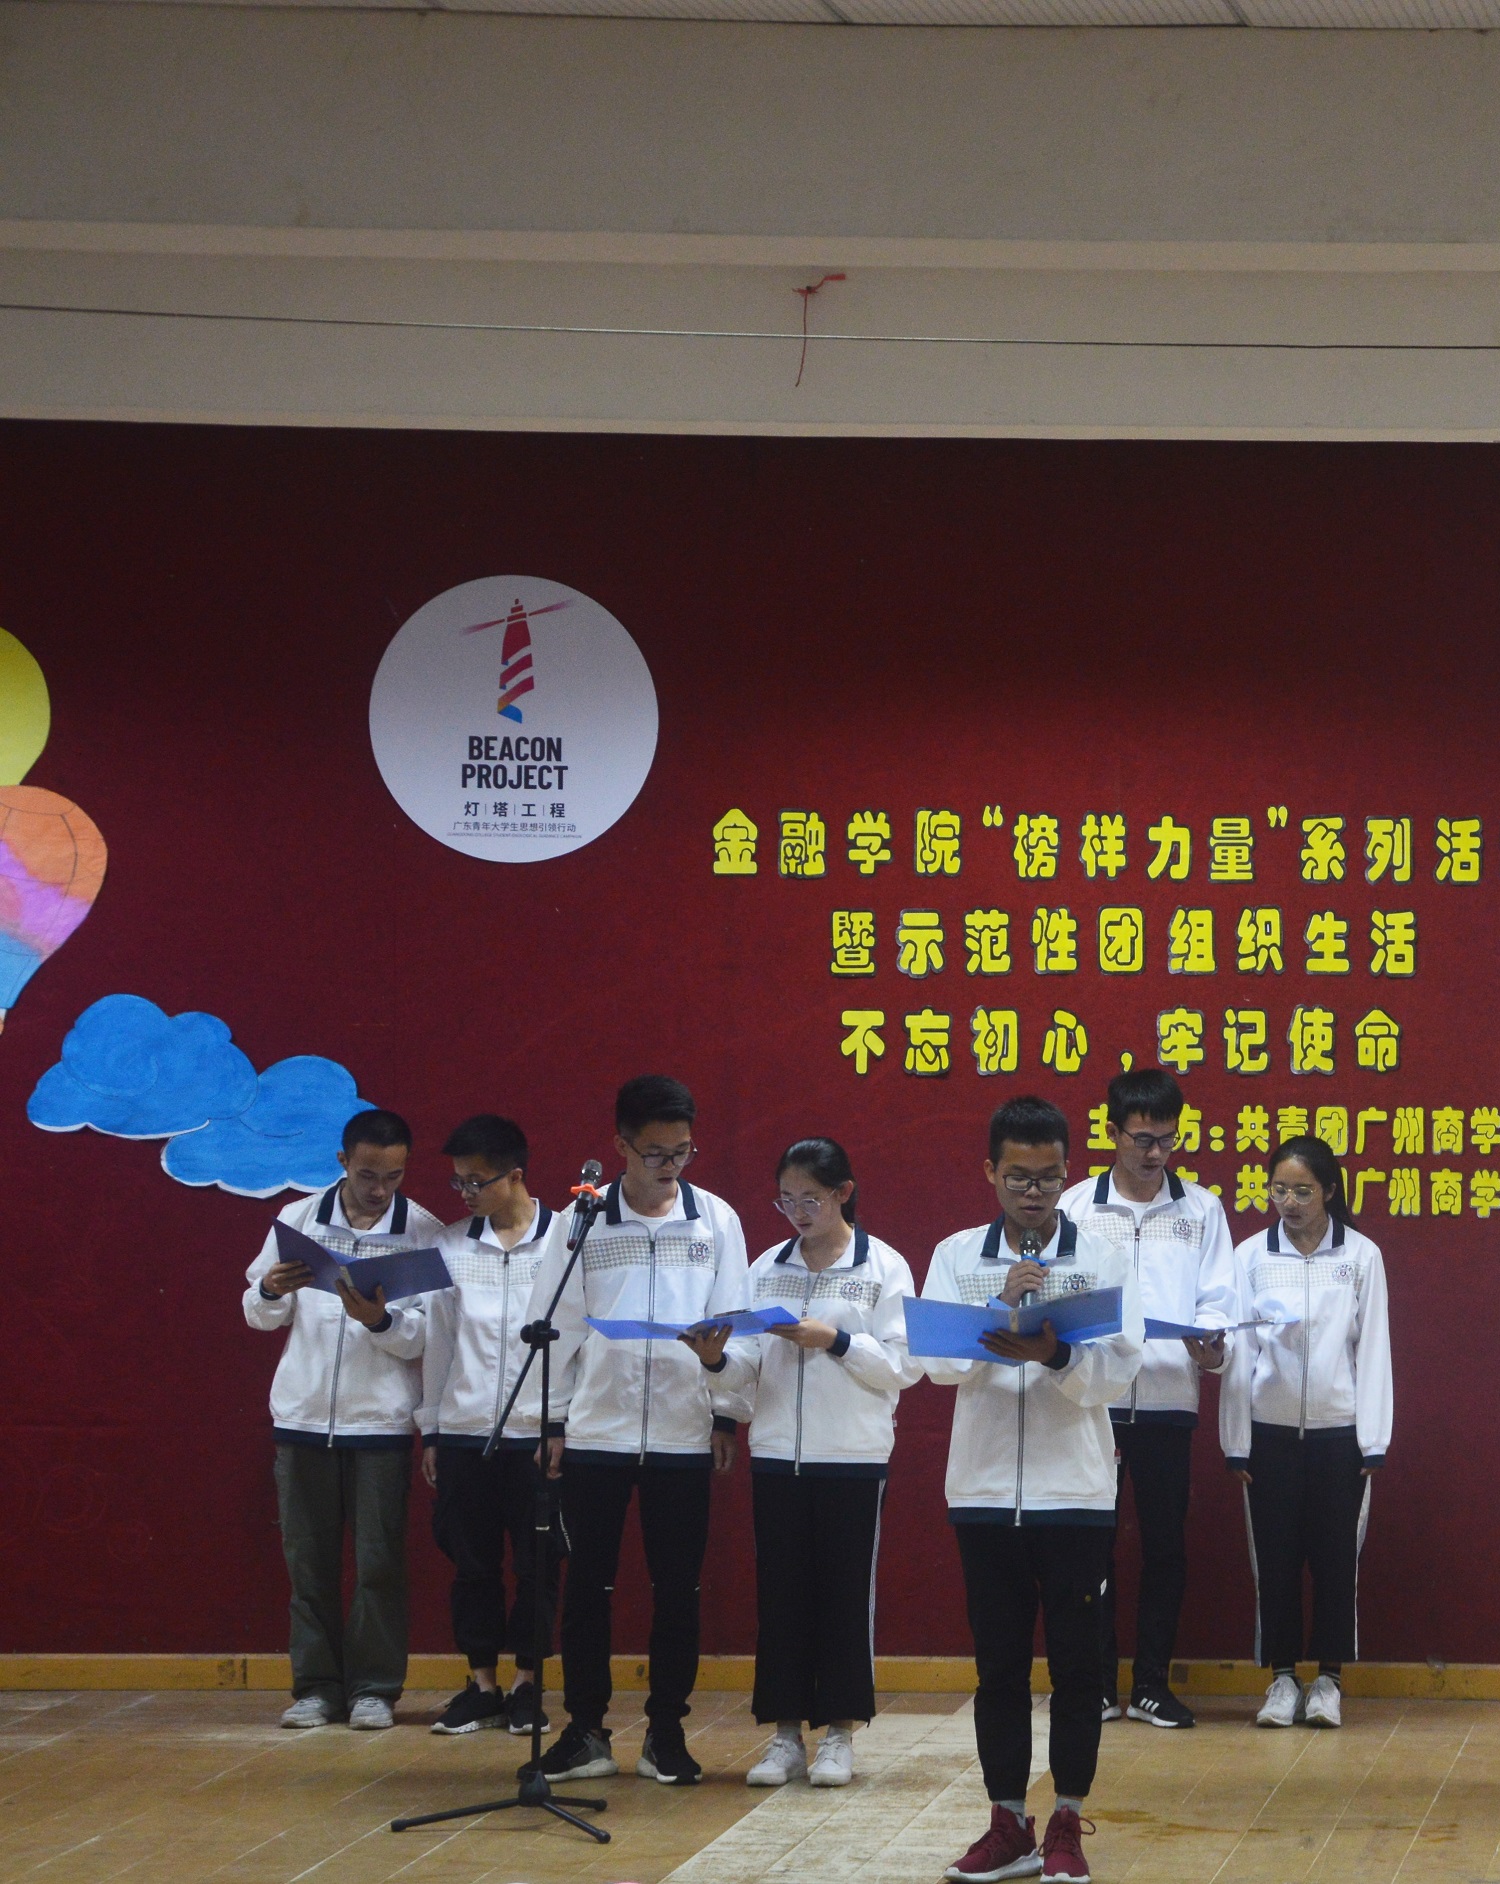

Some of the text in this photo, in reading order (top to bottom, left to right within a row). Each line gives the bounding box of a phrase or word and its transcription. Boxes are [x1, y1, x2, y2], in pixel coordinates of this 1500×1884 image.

[468, 735, 562, 762] BEACON
[461, 763, 568, 790] PROJECT
[453, 821, 576, 833] 广东青年大学生思想引领行动
[829, 905, 1417, 977] 暨示范性团组织生活
[839, 1005, 1400, 1075] 不忘初心，牢记使命
